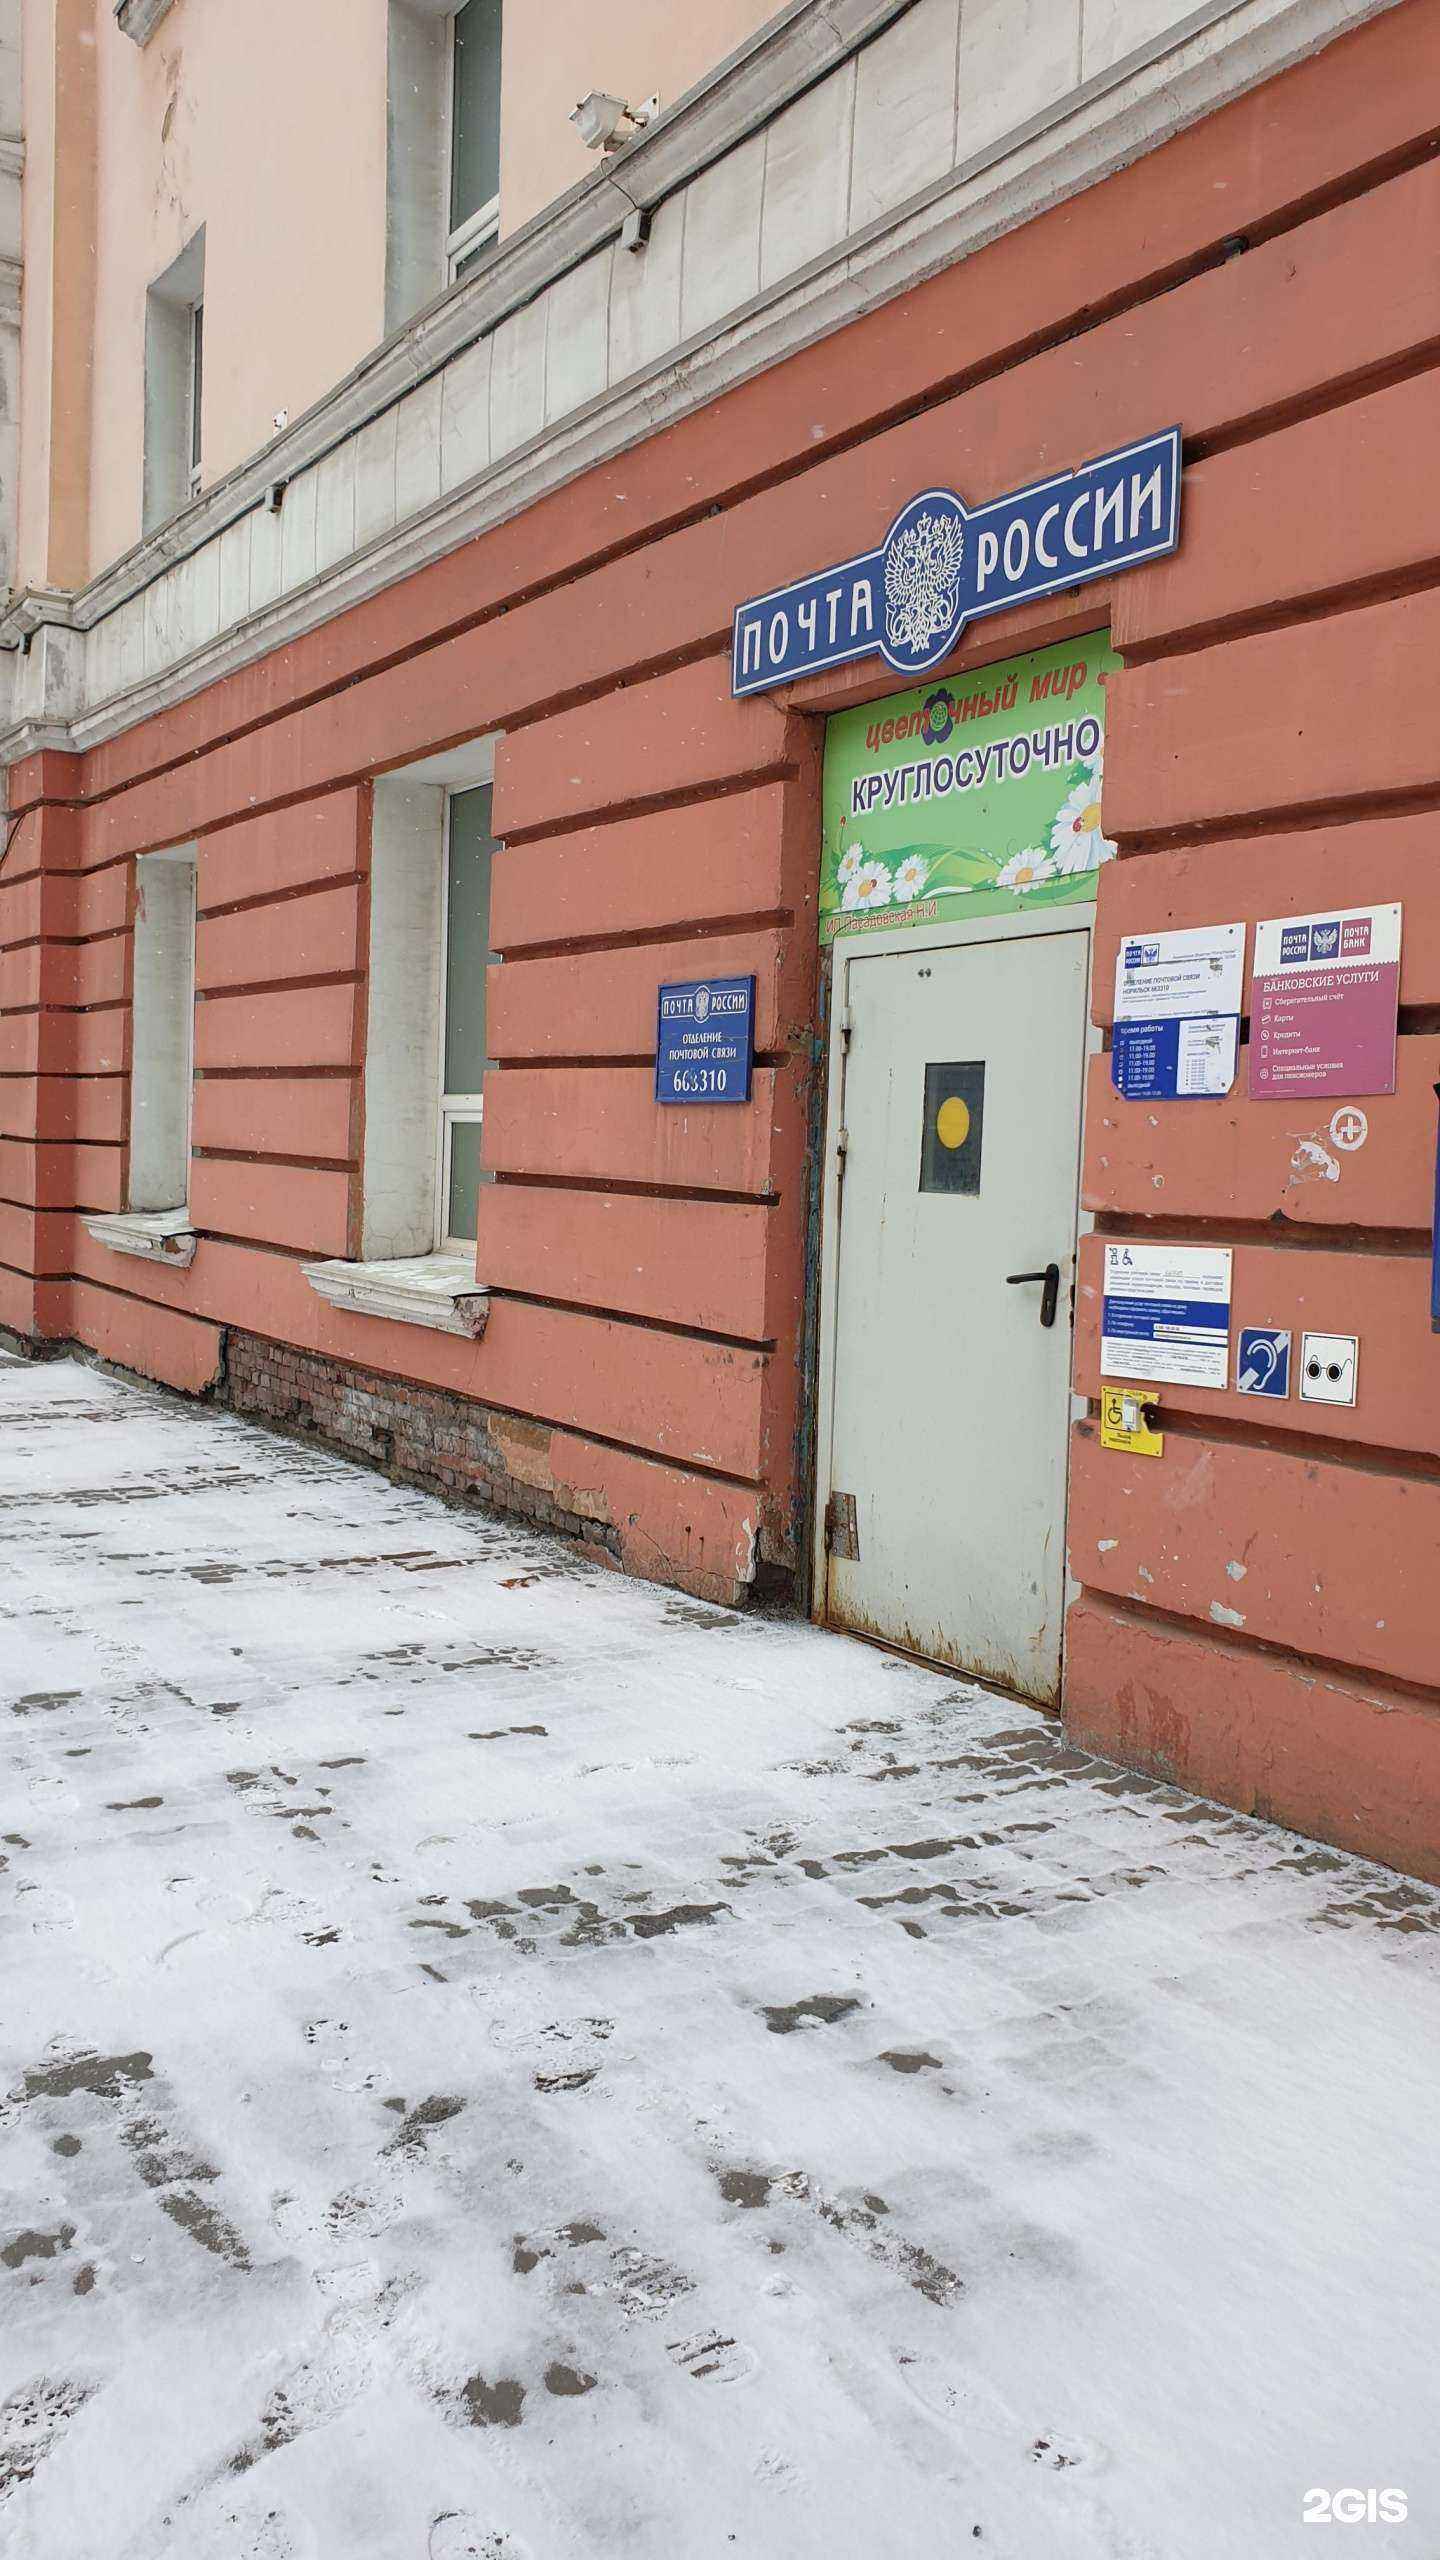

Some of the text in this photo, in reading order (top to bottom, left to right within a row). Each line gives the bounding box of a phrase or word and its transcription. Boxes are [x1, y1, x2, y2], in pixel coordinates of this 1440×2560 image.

[743, 464, 1161, 675] ПОЧТА РОССИИ
[1029, 660, 1088, 704] мир
[852, 718, 1101, 813] КРУГЛОСУТОЧНО
[1344, 926, 1369, 937] ПОЧТА
[1283, 935, 1307, 946] ПОЧТА
[1343, 937, 1365, 949] БАНК
[1282, 945, 1307, 956] РОССИИ
[1263, 970, 1380, 992] БАНКОВСКИЕ УСЛУГИ
[663, 993, 745, 1015] ПОЧТА РОССИИ
[682, 1032, 722, 1045] ОТДЕЛЕНИЕ
[669, 1046, 737, 1061] ПОЧТОВОЙ СВЯЗИ
